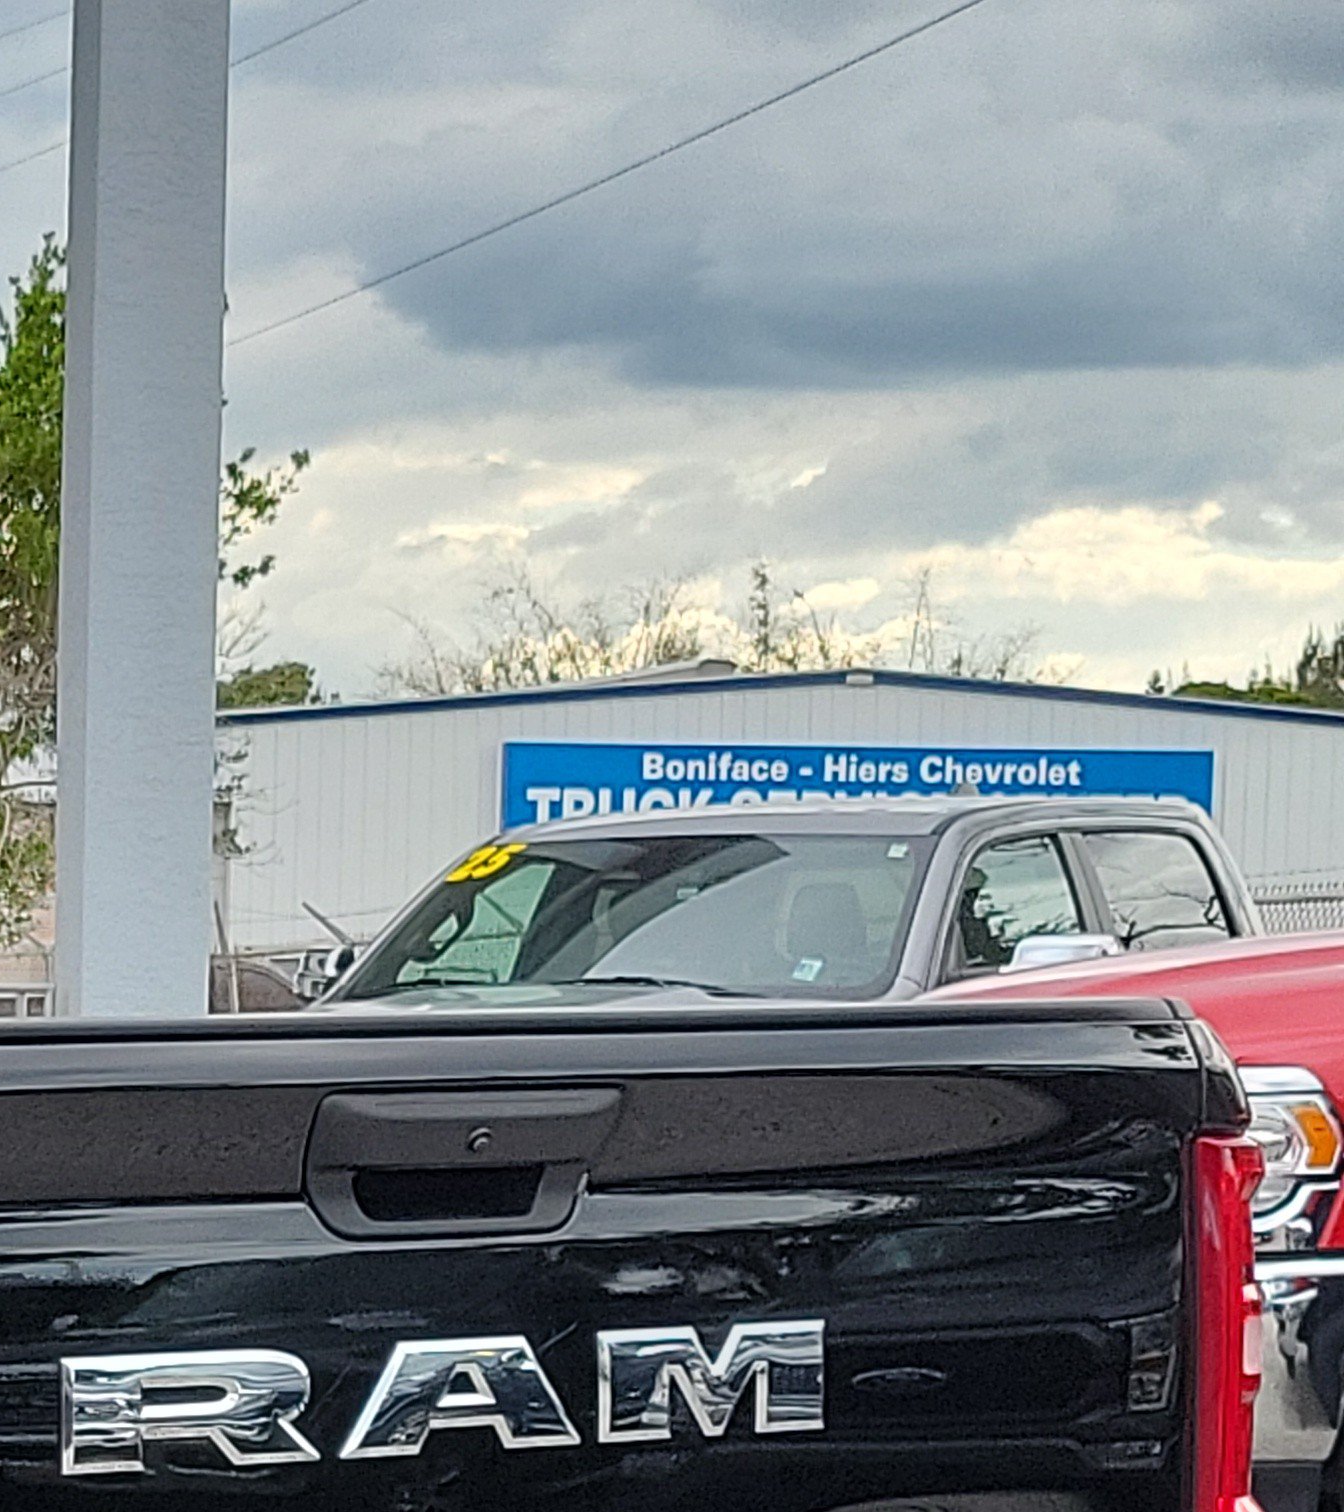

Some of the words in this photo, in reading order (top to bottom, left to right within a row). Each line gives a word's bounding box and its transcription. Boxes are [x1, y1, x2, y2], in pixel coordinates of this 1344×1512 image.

[643, 751, 789, 782] Boniface
[823, 754, 909, 784] Hiers
[920, 755, 1082, 786] Chevrolet
[61, 1319, 825, 1476] RAM
